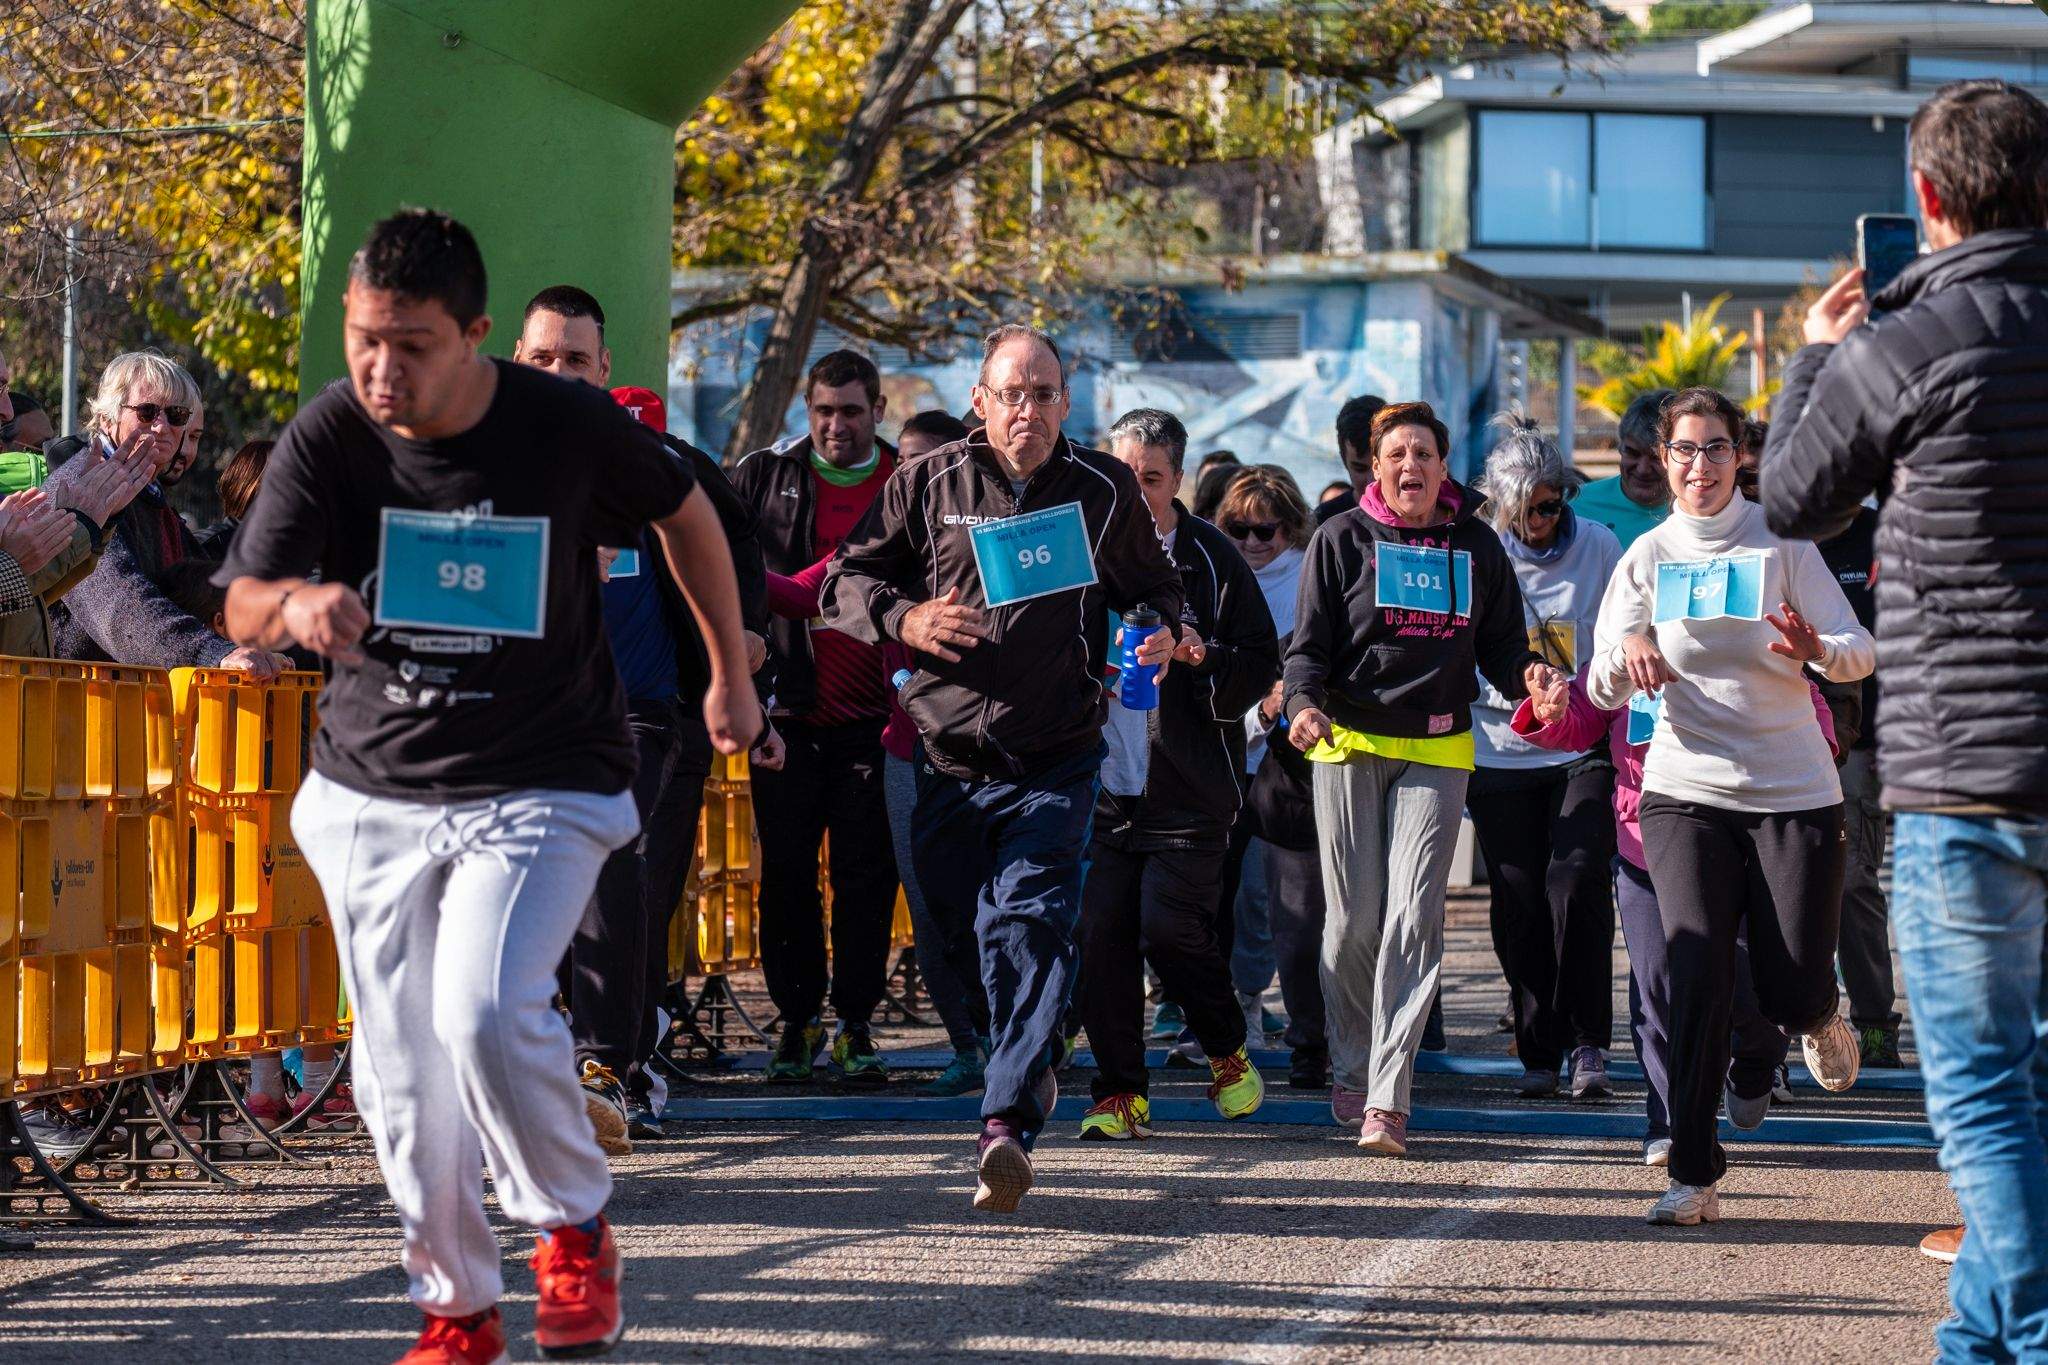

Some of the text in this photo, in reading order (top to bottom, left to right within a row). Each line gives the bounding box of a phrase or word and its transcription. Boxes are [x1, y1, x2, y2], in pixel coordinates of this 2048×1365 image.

[983, 525, 1001, 534] MILLA
[1041, 507, 1075, 520] VALLDOREIX
[997, 523, 1057, 542] MILLA OPEN
[1018, 544, 1052, 569] 96
[1396, 555, 1447, 567] MILLA OPEN
[437, 560, 486, 592] 98
[1404, 572, 1443, 591] 101
[1692, 582, 1723, 600] 97
[1395, 626, 1430, 637] Athletic
